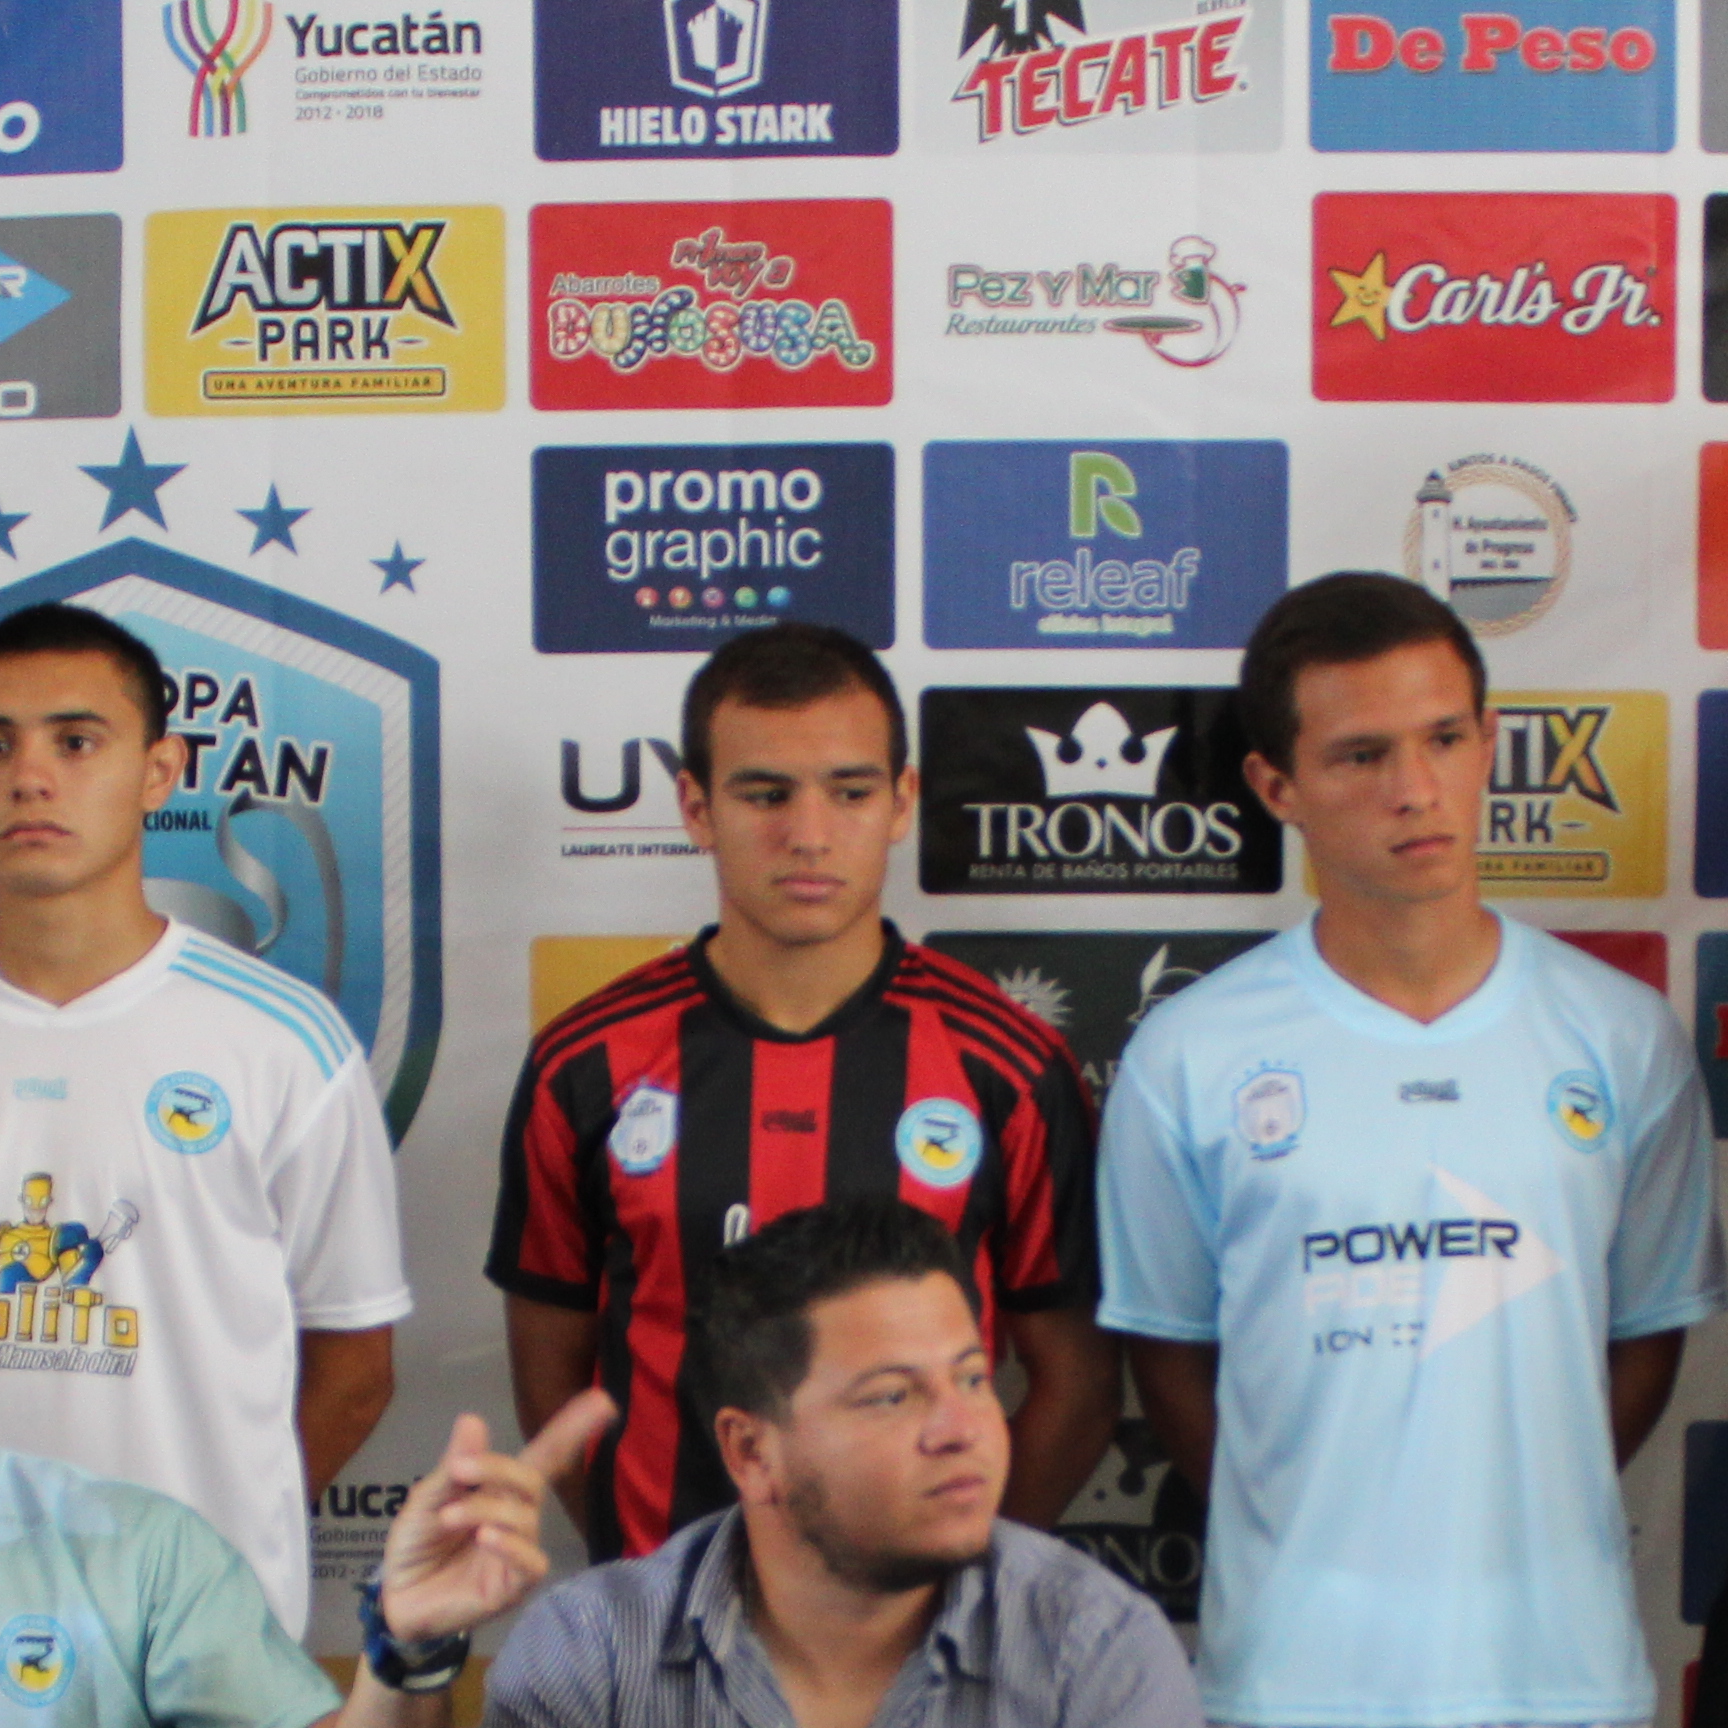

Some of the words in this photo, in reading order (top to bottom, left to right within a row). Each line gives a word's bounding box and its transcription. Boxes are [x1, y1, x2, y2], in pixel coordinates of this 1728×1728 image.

[284, 9, 483, 59] Yucatán
[1327, 14, 1445, 75] De
[1460, 12, 1658, 73] Peso
[294, 64, 378, 84] Gobierno
[382, 63, 412, 82] del
[417, 63, 483, 82] Estado
[952, 15, 1247, 143] TECATE
[295, 105, 332, 122] 2012
[599, 104, 706, 148] HIELO
[714, 102, 835, 146] STARK
[196, 222, 454, 332] ACTIX
[549, 271, 661, 297] Abarrotes
[947, 265, 1027, 306] Pez
[1077, 264, 1157, 305] Mar
[1385, 260, 1561, 334] Carl's
[1560, 263, 1663, 336] Jr.
[257, 316, 391, 362] PARK
[945, 312, 1098, 340] Restaurantes
[213, 379, 247, 392] UNA
[255, 377, 342, 391] AVENTURA
[350, 375, 432, 389] FAMILIAR
[603, 466, 823, 523] promo
[604, 517, 823, 582] graphic
[1010, 547, 1201, 611] releaf
[649, 613, 718, 631] Marketing
[962, 801, 1242, 861] TRONOS
[968, 863, 1027, 881] RENTA
[1032, 862, 1057, 880] DE
[1062, 858, 1130, 880] BAÑOS
[1301, 1218, 1520, 1274] POWER
